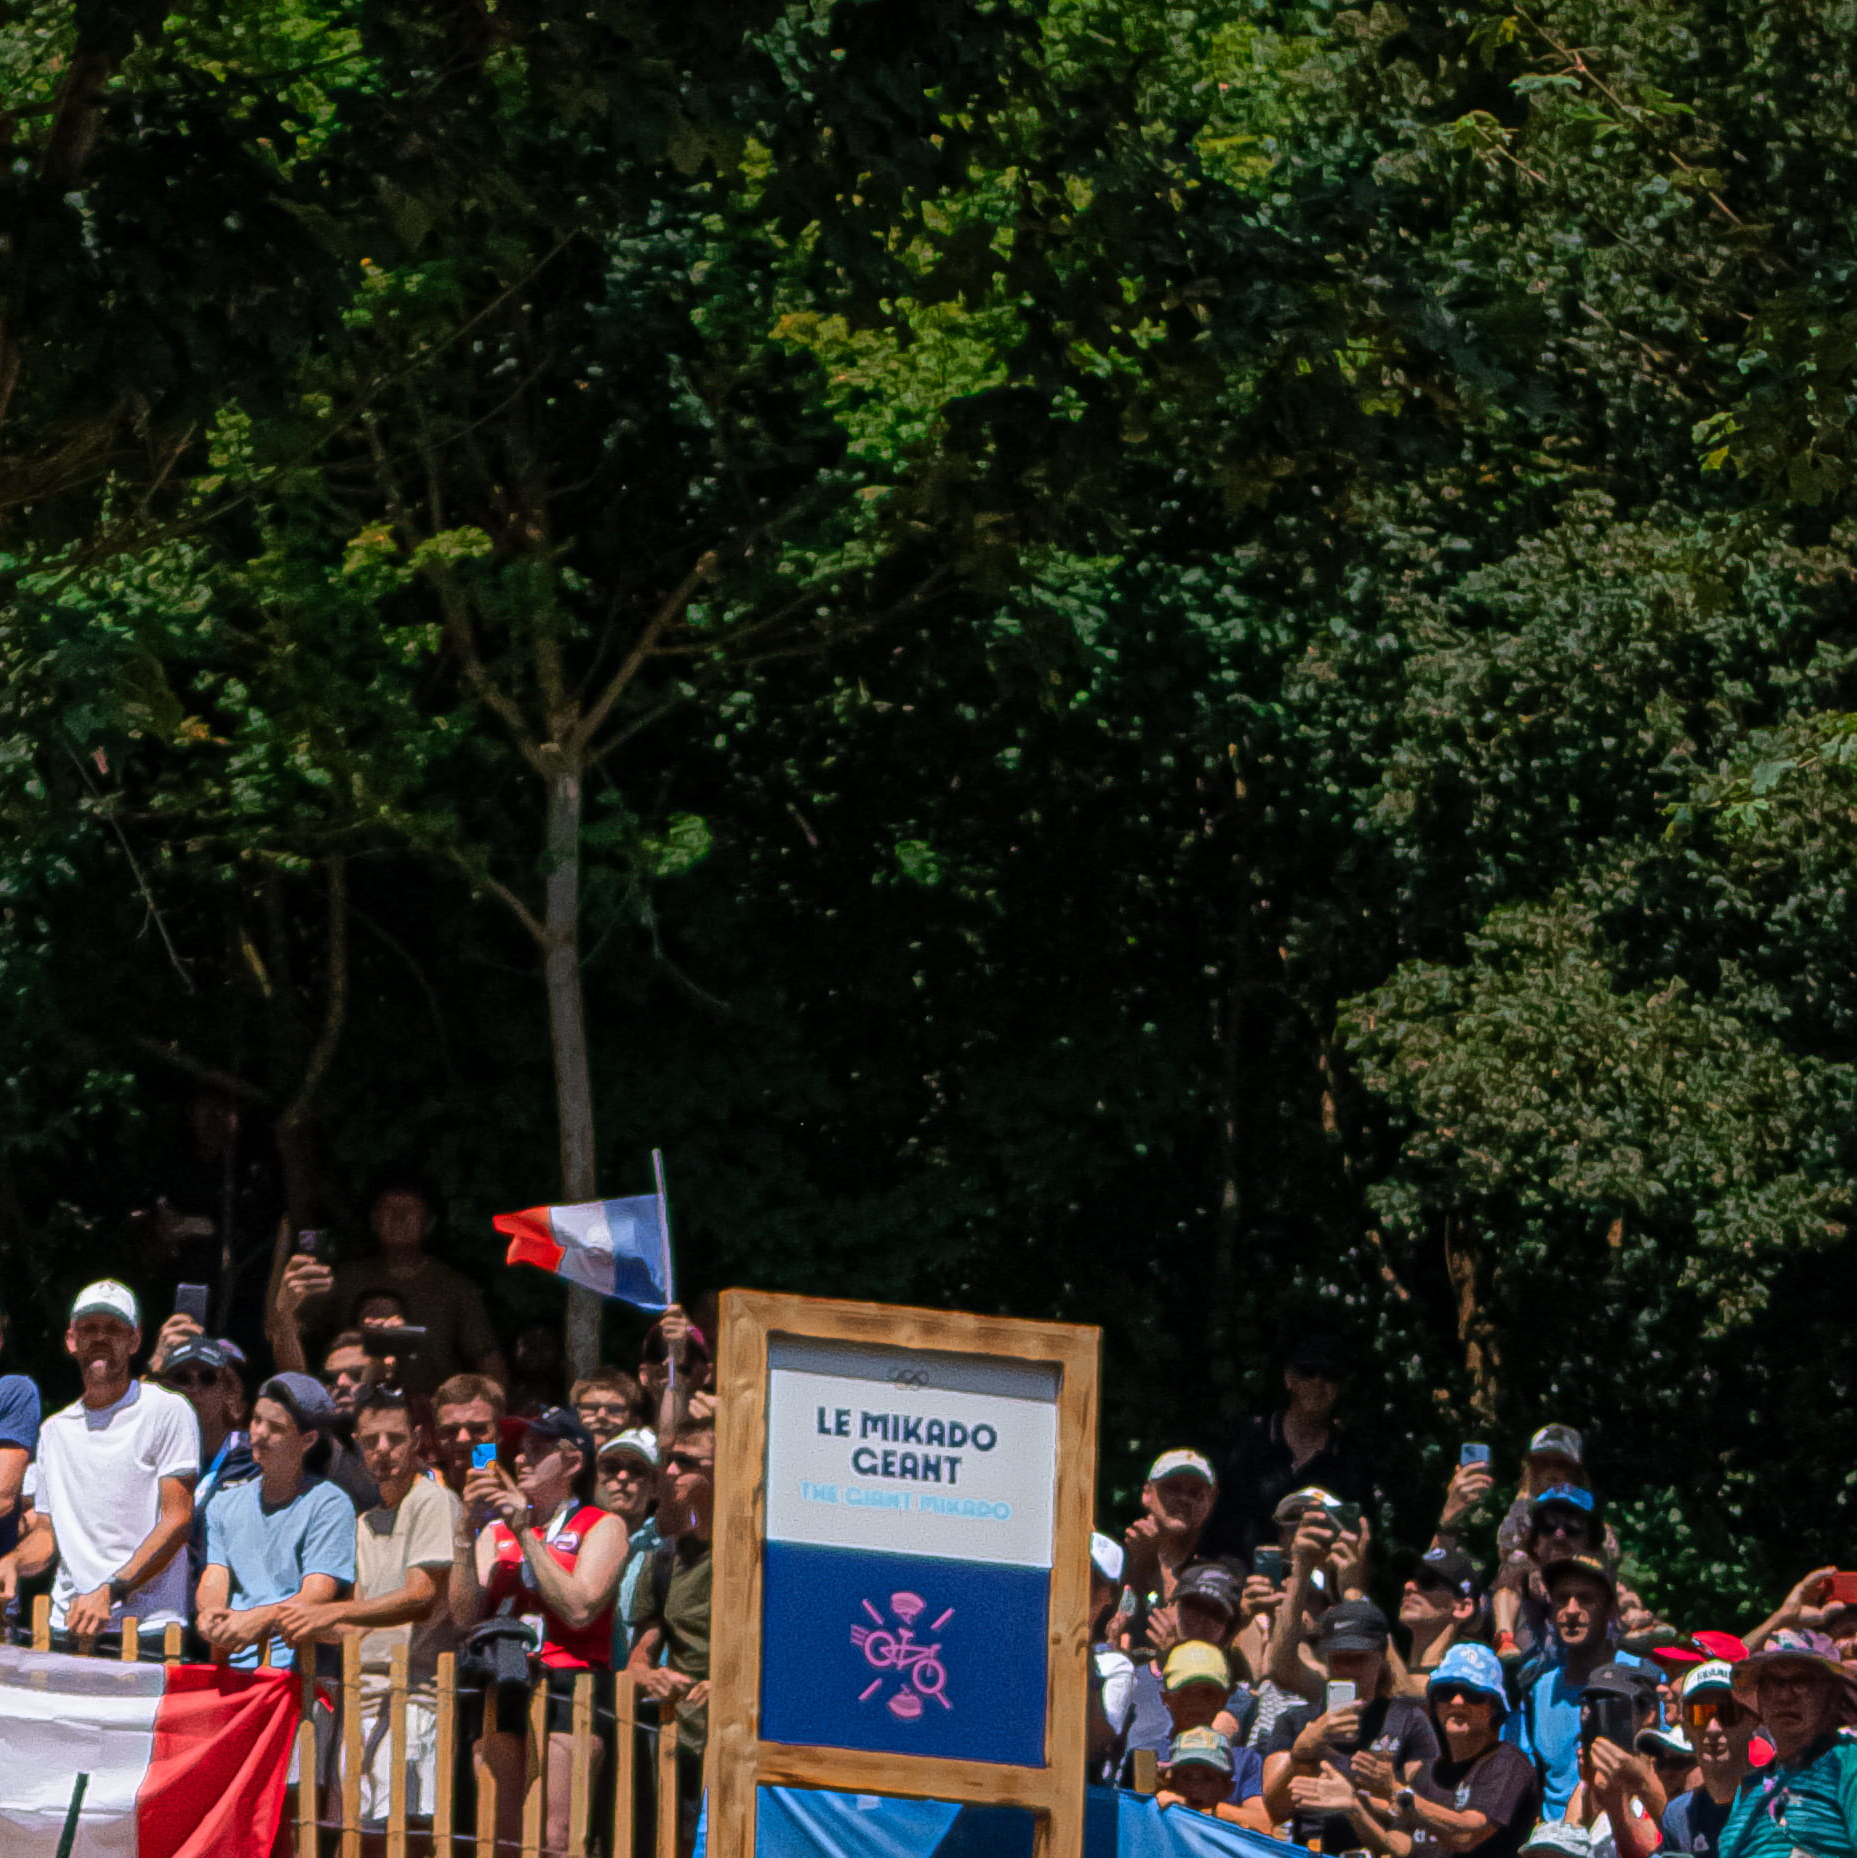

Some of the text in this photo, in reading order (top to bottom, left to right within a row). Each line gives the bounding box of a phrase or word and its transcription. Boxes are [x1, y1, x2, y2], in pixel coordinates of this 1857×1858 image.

[816, 1406, 998, 1451] LE MIKADO
[851, 1446, 963, 1485] GEANT
[799, 1480, 1012, 1521] THE GIANT MIKADO
